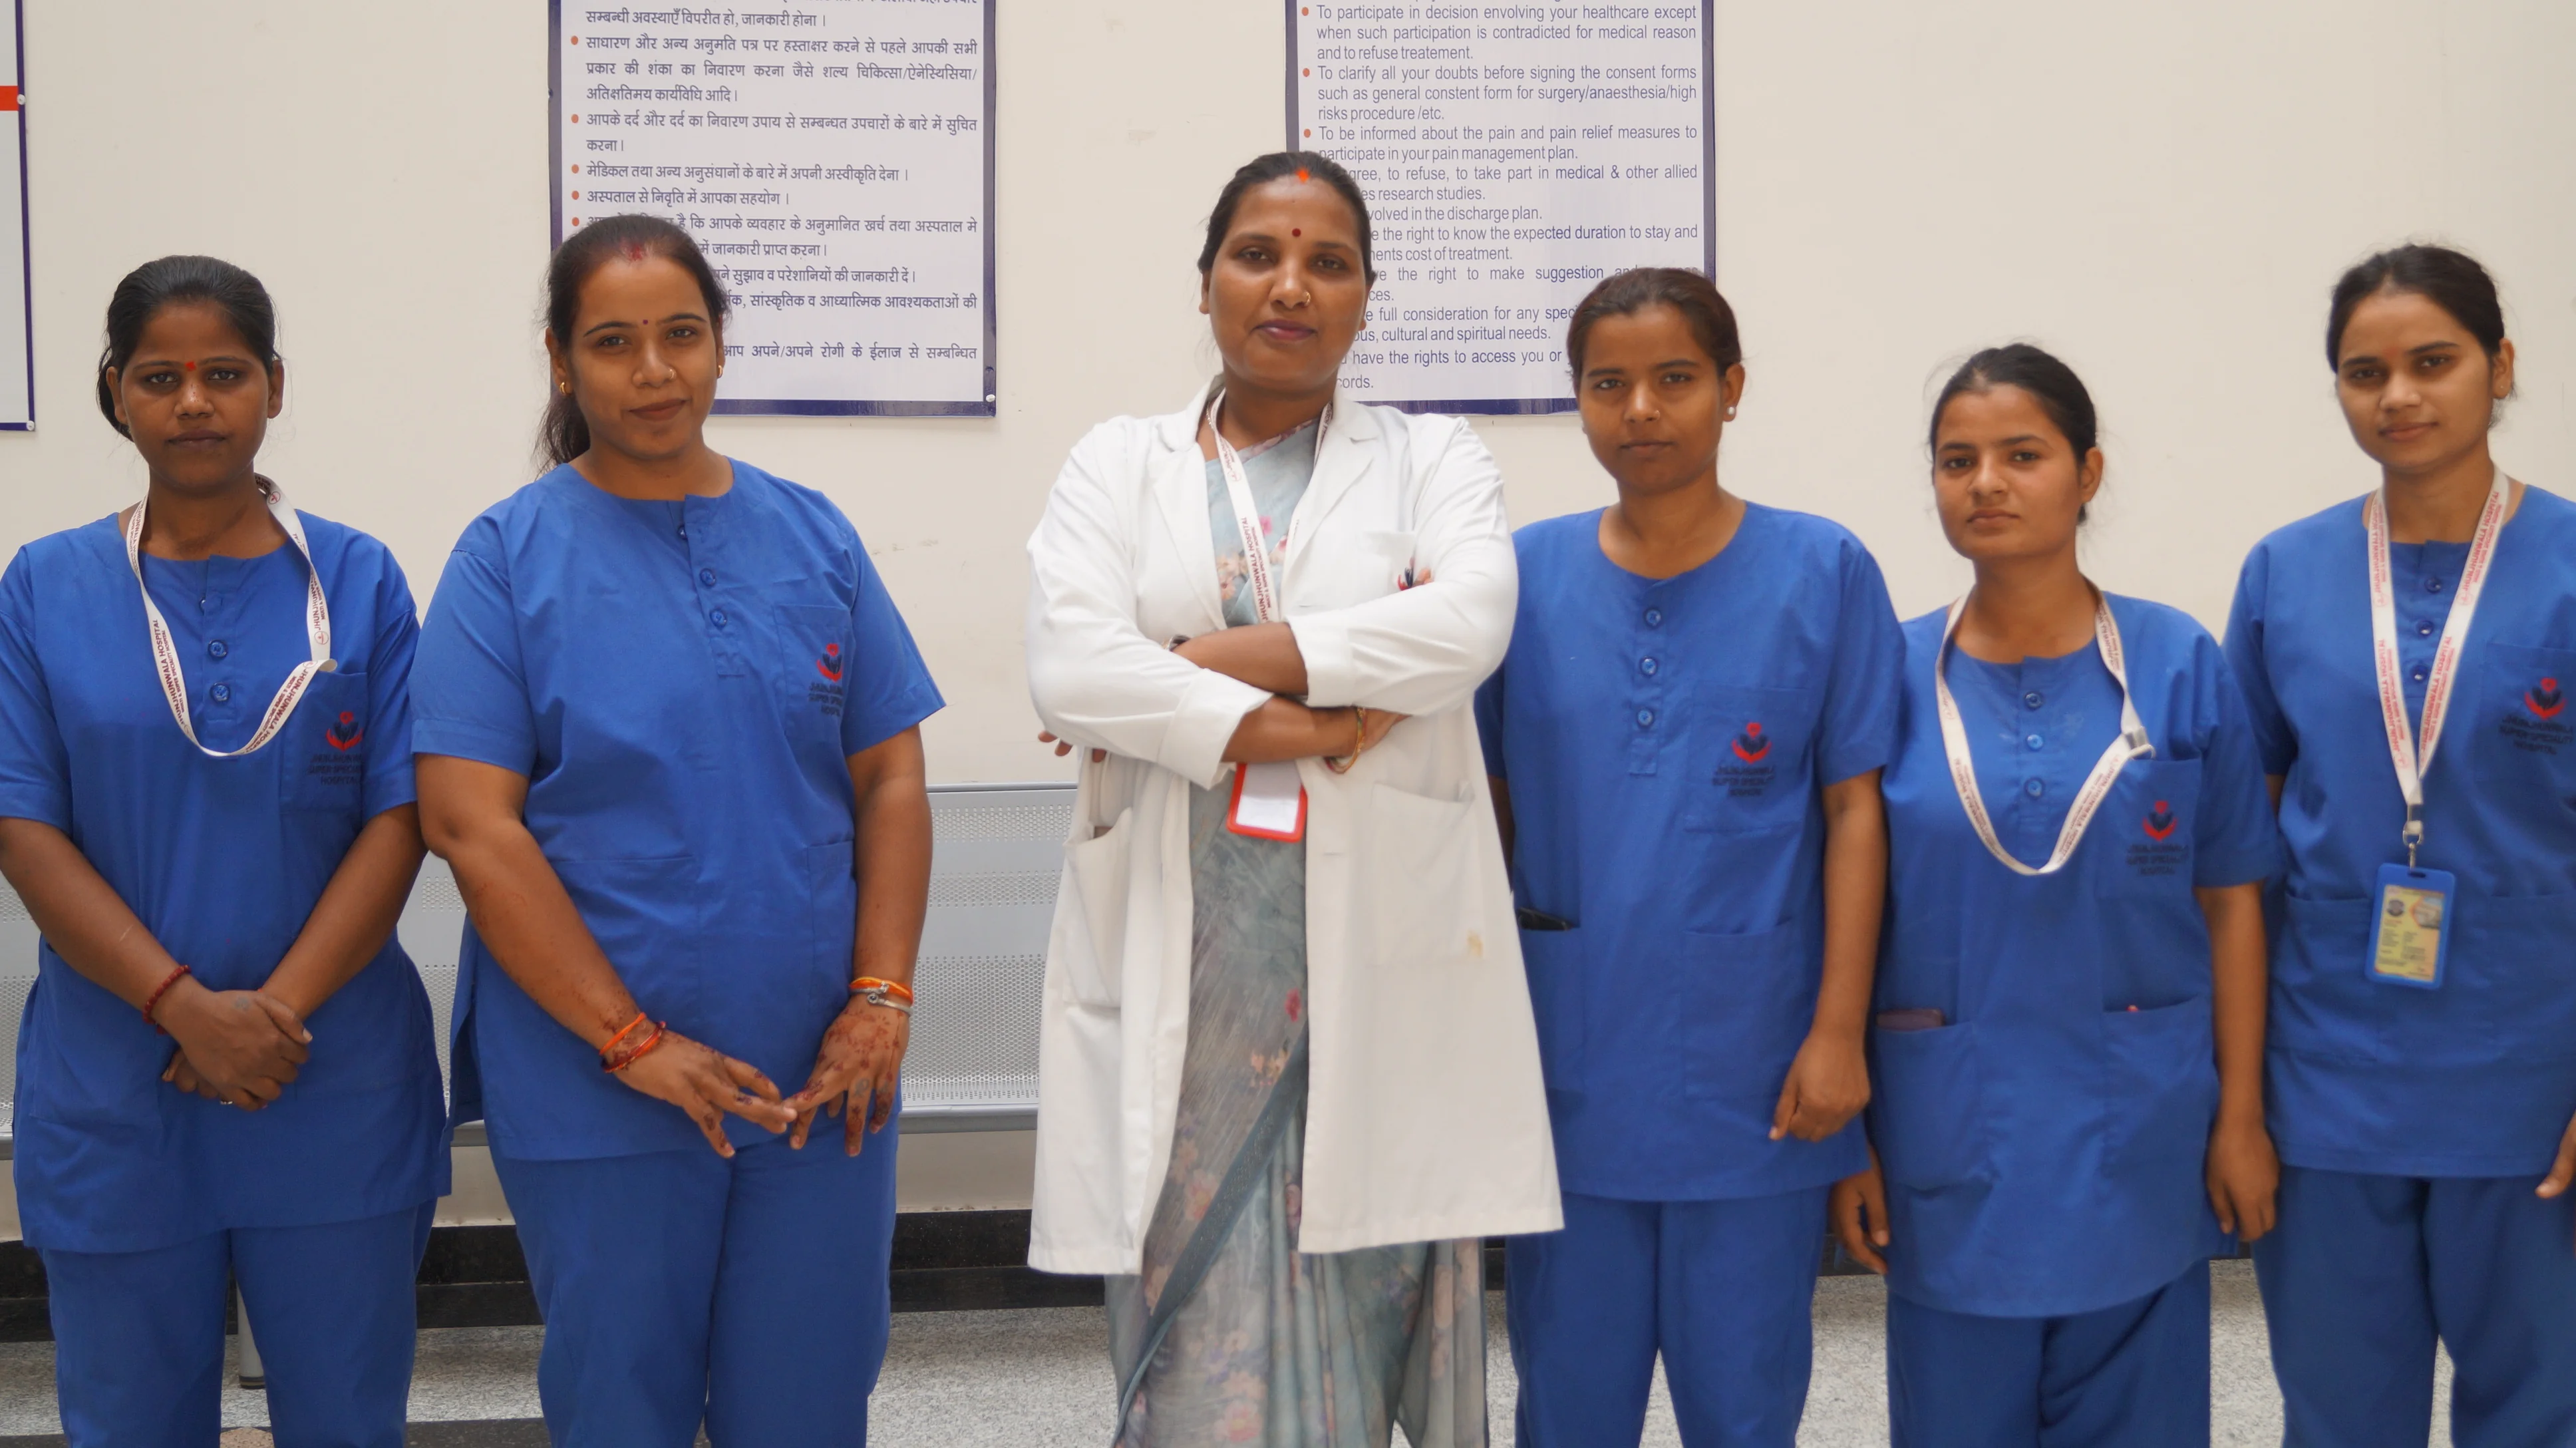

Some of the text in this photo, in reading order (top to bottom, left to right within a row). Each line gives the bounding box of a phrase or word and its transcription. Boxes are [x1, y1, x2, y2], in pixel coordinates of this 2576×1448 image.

[1317, 5, 1696, 22] To participate in decision envolving your healthcare except
[585, 33, 977, 55] साधारण और अन्य अनुमति पत्र पर हस्ताक्षर करने से पहले आपकी सभी
[1317, 25, 1695, 43] when such participation is contradicted for medical reason
[1318, 45, 1473, 59] and to refuse treatement.
[585, 63, 616, 74] प्रकार
[624, 59, 639, 75] की
[648, 60, 673, 75] शंका
[681, 64, 696, 75] का
[704, 60, 745, 76] निवारण
[753, 65, 784, 77] करना
[792, 61, 814, 77] जैसे
[823, 67, 849, 78] शल्य
[1317, 65, 1696, 83] To clarify all your doubts before signing the consent forms
[1319, 86, 1347, 100] such
[1353, 89, 1368, 100] as
[1372, 86, 1420, 103] general
[1425, 87, 1479, 99] constent
[1484, 85, 1512, 99] form
[1517, 85, 1533, 99] for
[587, 109, 621, 125] आपके
[624, 109, 639, 126] दर्द
[643, 110, 666, 126] और
[669, 110, 685, 127] दर्द
[688, 116, 703, 126] का
[707, 111, 748, 127] निवारण
[752, 116, 781, 128] उपाय
[785, 112, 796, 128] से
[851, 114, 890, 129] उपचारों
[893, 114, 905, 129] के
[908, 114, 928, 130] बारे
[931, 114, 942, 130] में
[1319, 125, 1696, 142] To be informed about the pain and pain relief measures to
[1388, 164, 1696, 182] to refuse, to take part in medical & other allied
[690, 213, 705, 229] कि
[709, 214, 743, 229] आपके
[746, 219, 786, 231] व्यवहार
[790, 214, 801, 230] के
[805, 215, 860, 236] अनुमानित
[864, 215, 885, 231] खर्च
[889, 220, 911, 232] तथा
[915, 221, 963, 232] अस्पताल
[1383, 224, 1697, 244] the right to know the expected duration to stay and
[750, 291, 805, 311] सांस्कृतिक
[808, 296, 816, 306] व
[885, 292, 959, 308] आवश्यकताओं
[963, 293, 977, 308] की
[1382, 325, 1550, 343] cultural and spiritual needs.
[820, 341, 844, 357] रोगी
[851, 342, 863, 357] के
[869, 341, 901, 361] ईलाज
[908, 343, 919, 358] से
[1241, 517, 1254, 551] HOSPITAL
[1249, 554, 1268, 621] JHUNJHUNWALA
[152, 620, 185, 725] JHUNJHUNWALA HOSPITAL
[268, 668, 309, 731] JHUNJHUNWALA
